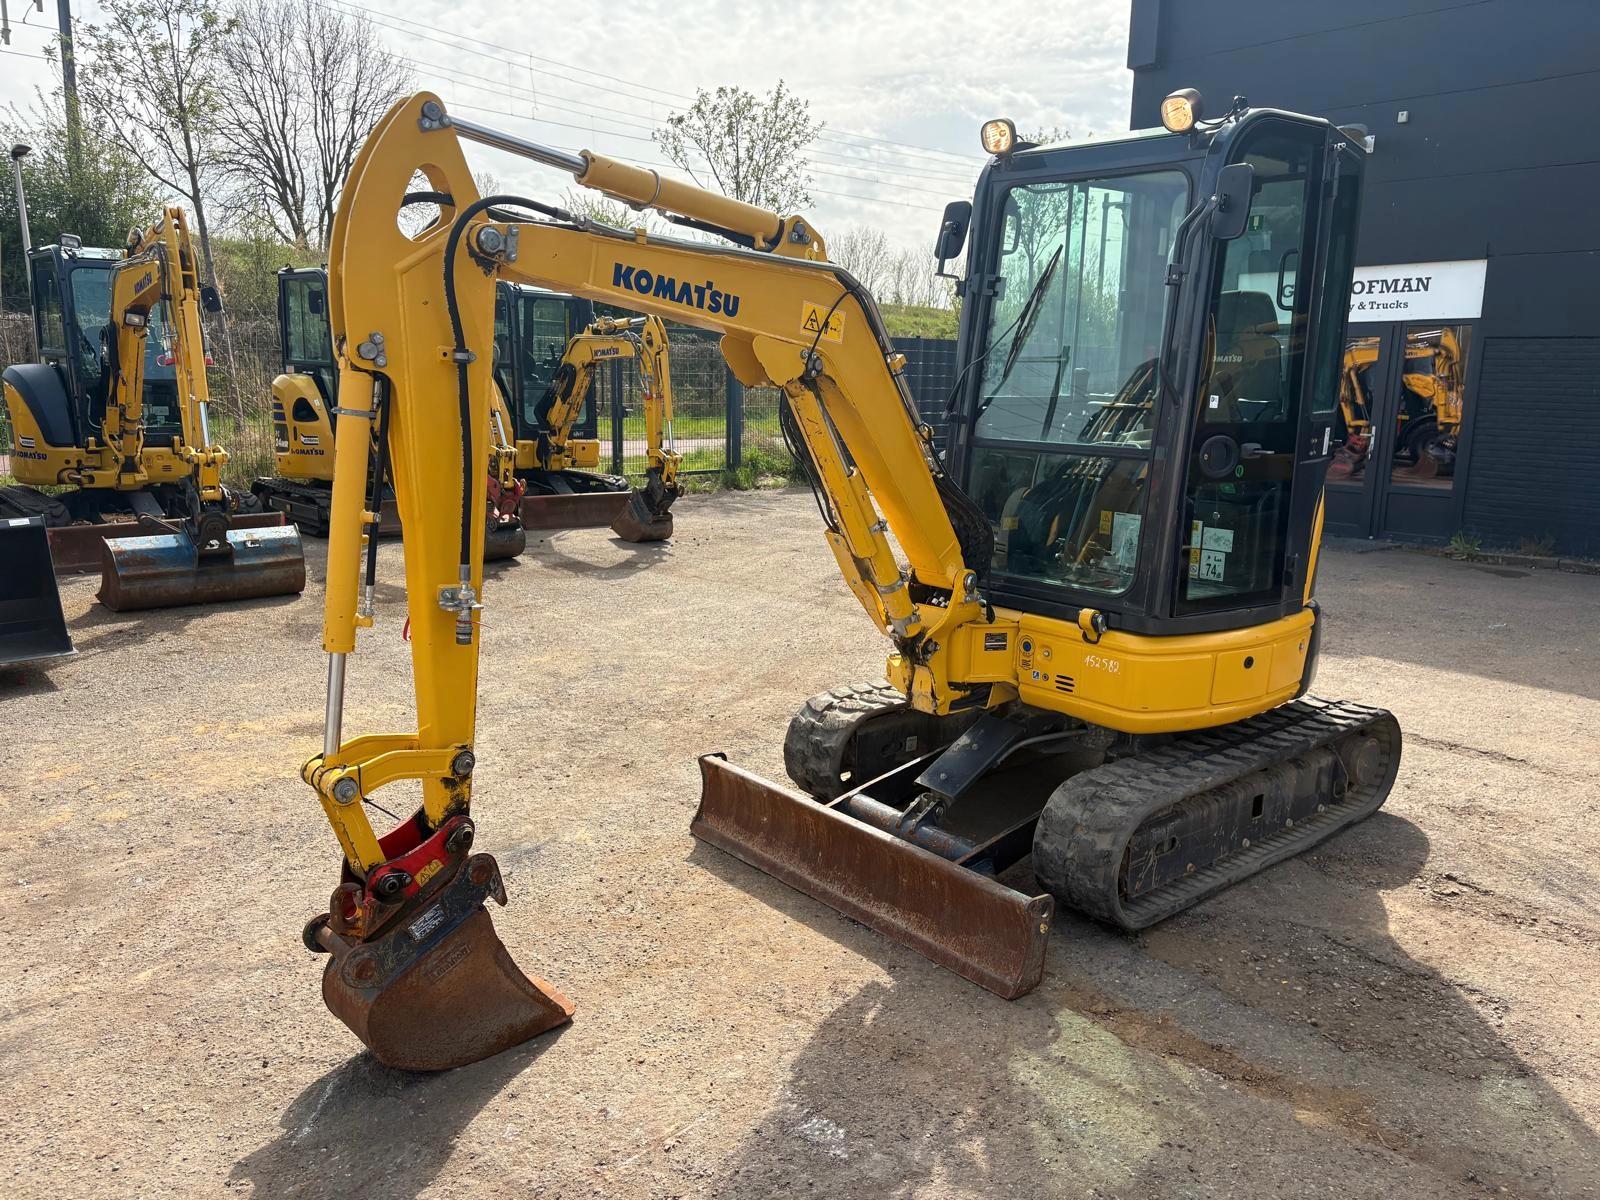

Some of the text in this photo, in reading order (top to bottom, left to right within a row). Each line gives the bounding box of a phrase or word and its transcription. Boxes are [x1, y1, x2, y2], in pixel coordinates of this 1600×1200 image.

[612, 262, 740, 317] KOMATSU
[1357, 302, 1366, 310] &
[1368, 300, 1409, 310] Trucks
[17, 451, 47, 461] KOMATSU
[291, 448, 324, 456] KOMATSU
[1206, 563, 1216, 577] 74
